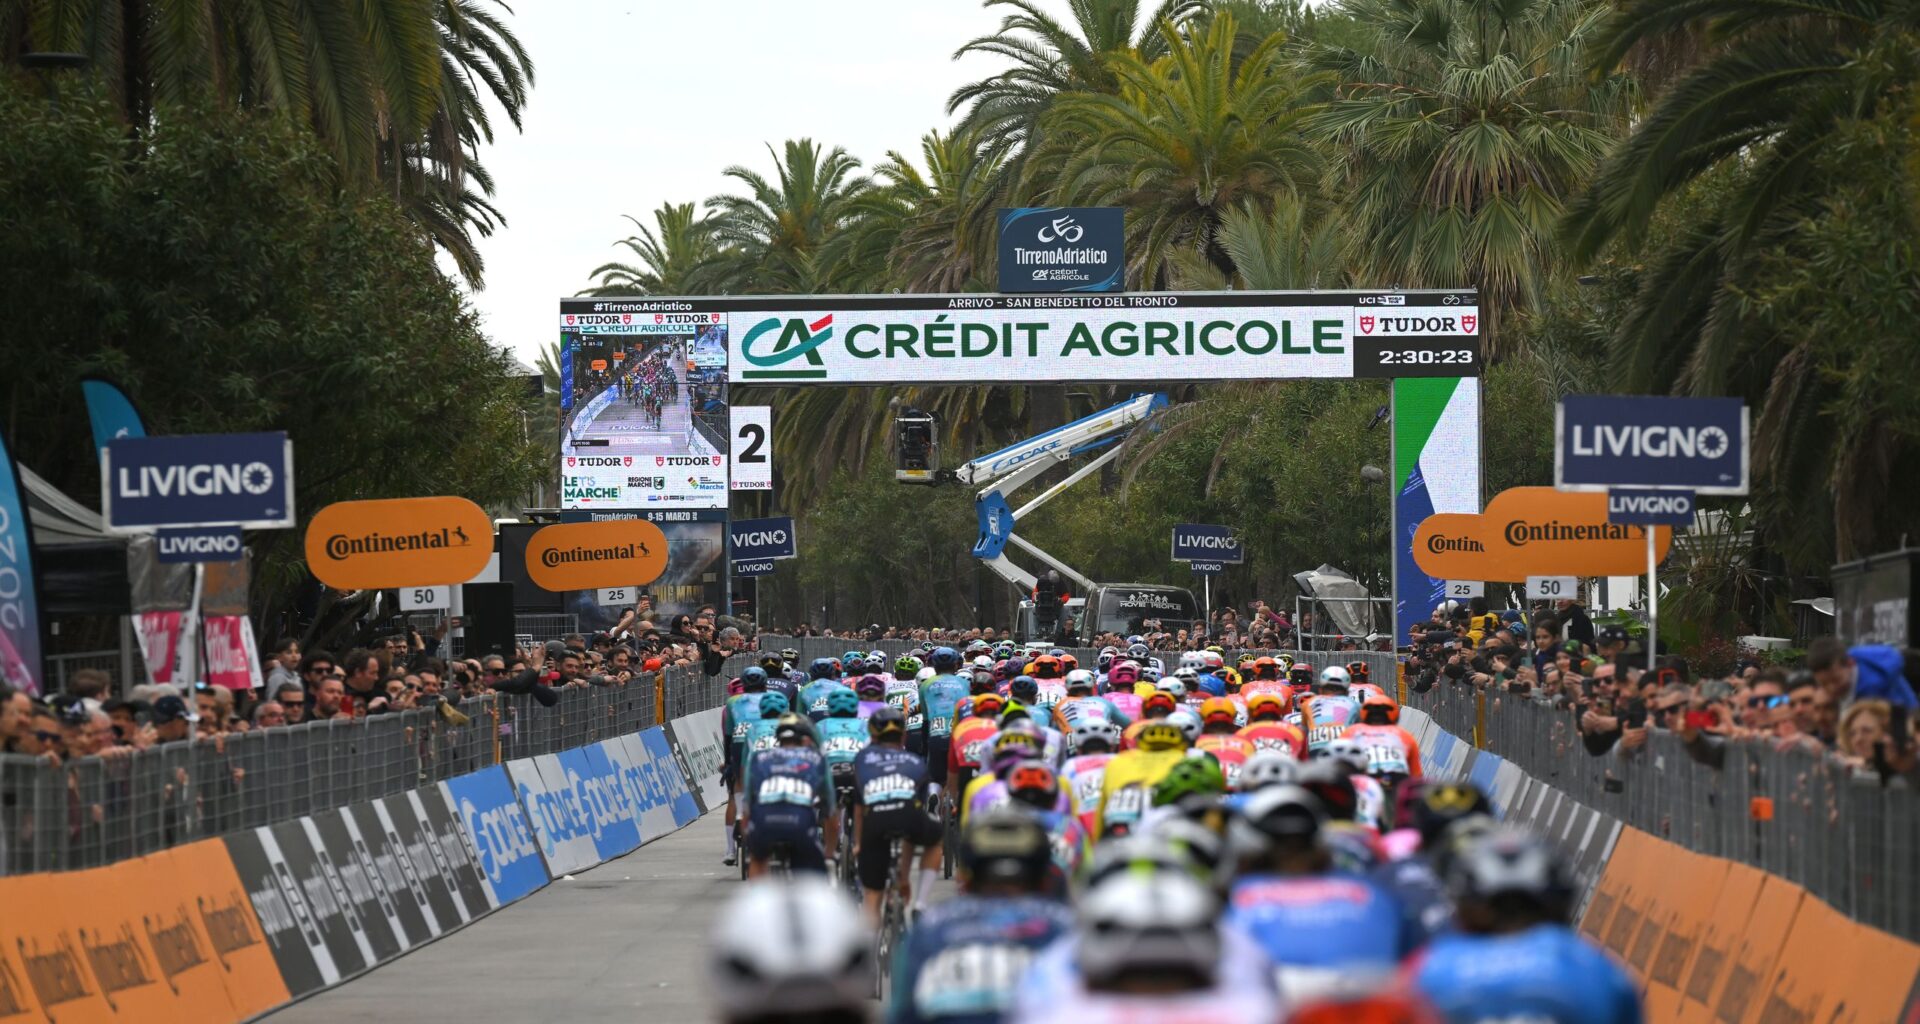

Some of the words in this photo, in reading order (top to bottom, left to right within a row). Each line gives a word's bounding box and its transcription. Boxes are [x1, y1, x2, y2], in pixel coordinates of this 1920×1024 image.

[1014, 247, 1108, 265] TirrenoAdriatico
[593, 302, 693, 312] #TirrenoAdriatico
[948, 298, 994, 308] ARRIVO
[1006, 298, 1033, 308] SAN
[1034, 297, 1102, 308] BENEDETTO
[1105, 297, 1125, 307] DEL
[1128, 296, 1178, 307] TRONTO
[577, 315, 621, 324] TUDOR
[665, 314, 709, 324] TUDOR
[1379, 317, 1457, 332] TUDOR
[844, 314, 1049, 358] CRÉDIT
[1059, 319, 1344, 358] AGRICOLE
[1379, 350, 1473, 364] 2:30:23
[738, 423, 766, 463] 2
[1572, 424, 1730, 459] LIVIGNO
[578, 457, 622, 467] TUDOR
[666, 456, 710, 466] TUDOR
[119, 461, 274, 498] LIVIGNO
[1609, 496, 1690, 514] LIVIGNO
[647, 512, 664, 521] 9-15
[665, 511, 691, 521] MARZO
[1504, 520, 1630, 546] Continental
[159, 535, 240, 554] LIVIGNO
[325, 528, 449, 561] Continental
[1178, 534, 1238, 550] LIVIGNO
[541, 543, 634, 568] Continental
[738, 562, 774, 573] LIVIGNO
[1191, 563, 1222, 571] LIVIGNO
[1454, 584, 1471, 595] 25
[1539, 579, 1561, 596] 50
[413, 589, 435, 604] 50
[608, 590, 625, 601] 25
[1150, 602, 1182, 610] PEOPLE
